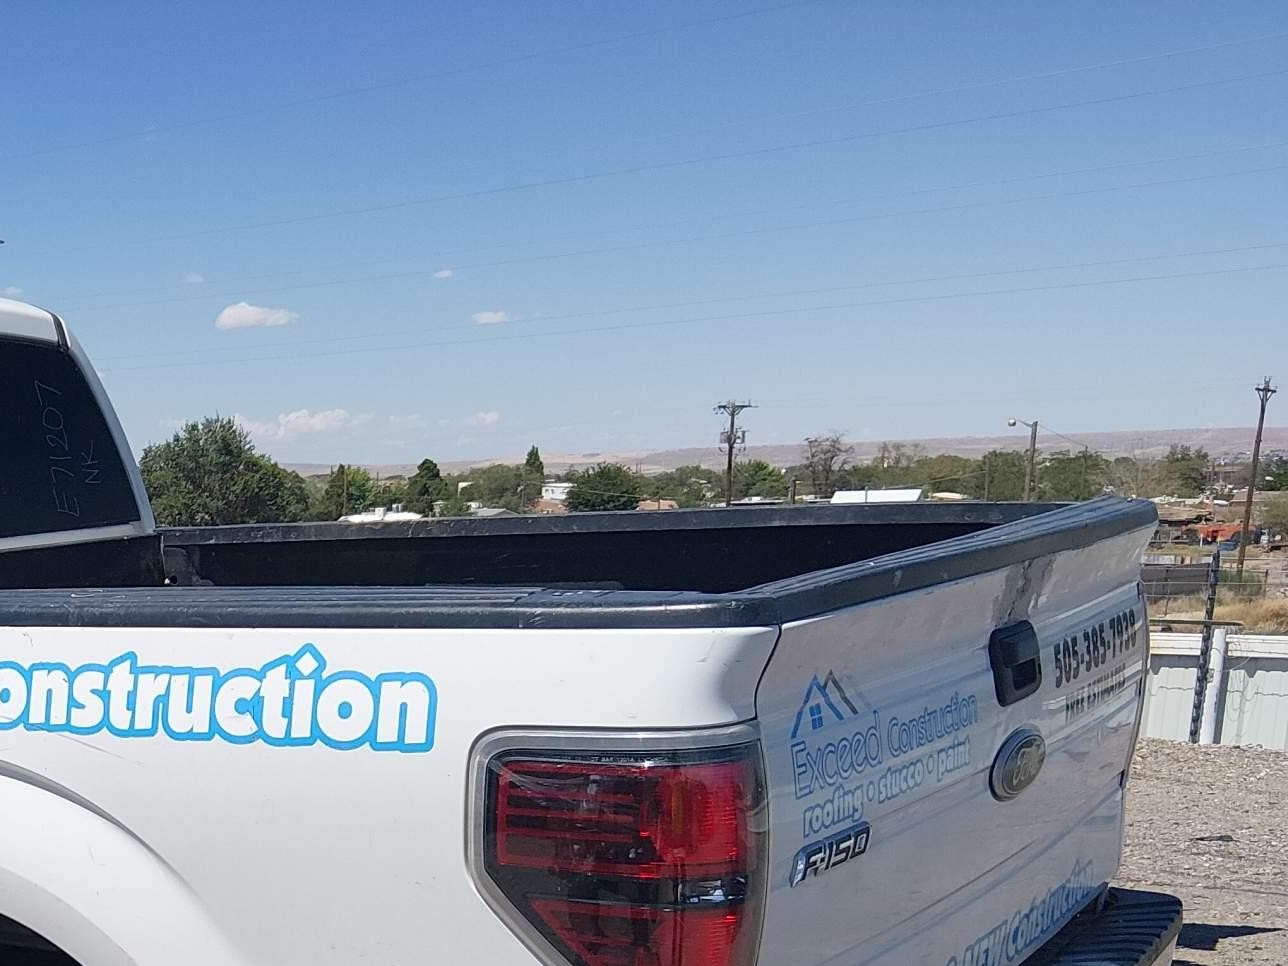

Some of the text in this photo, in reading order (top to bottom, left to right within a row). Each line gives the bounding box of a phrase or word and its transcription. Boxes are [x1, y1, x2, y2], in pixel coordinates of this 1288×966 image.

[1053, 608, 1137, 689] 505-385-7938
[791, 692, 978, 800] Exceed Construction
[803, 735, 970, 839] roofing stucco paint
